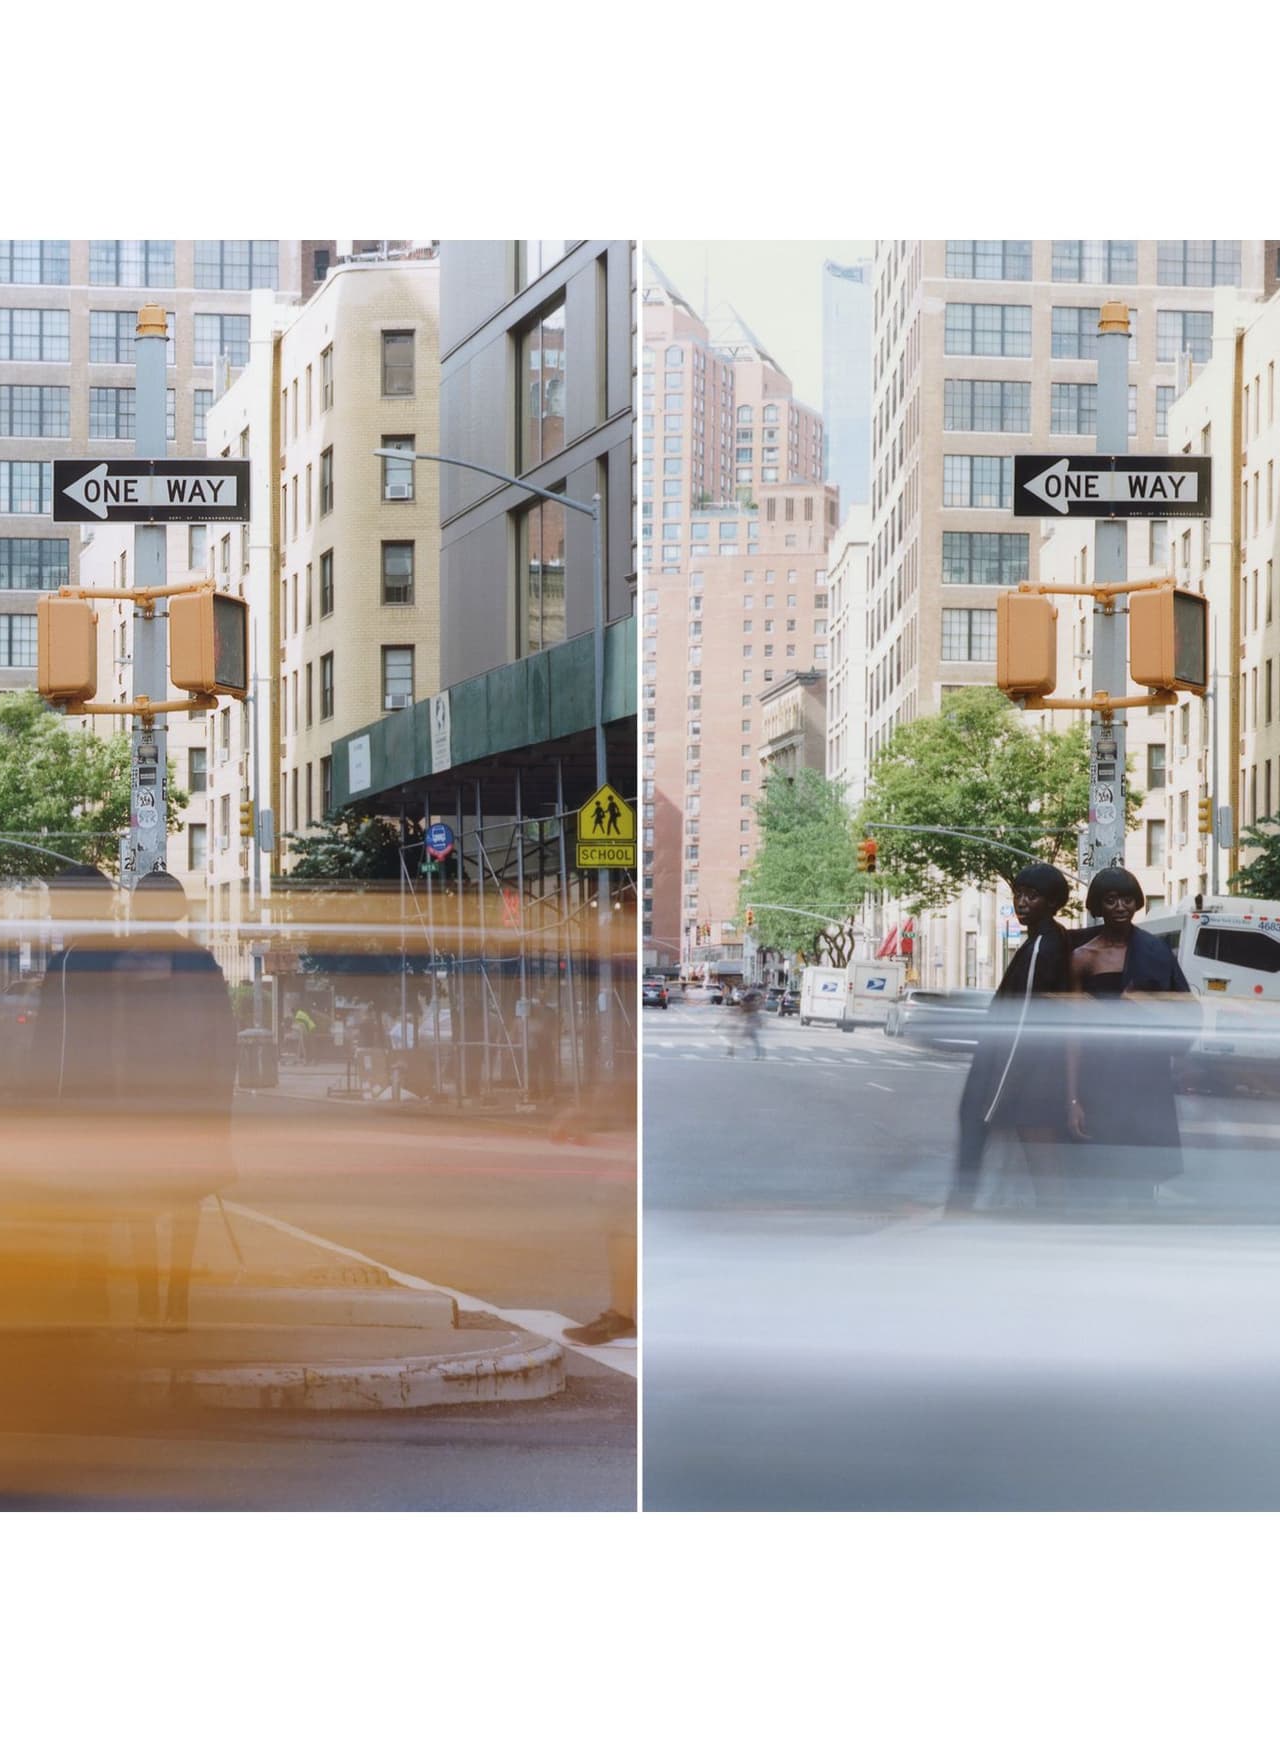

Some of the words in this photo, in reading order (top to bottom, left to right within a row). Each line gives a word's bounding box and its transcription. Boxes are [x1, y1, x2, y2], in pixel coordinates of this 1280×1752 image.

[84, 479, 138, 503] ONE
[166, 479, 224, 503] WAY
[1044, 474, 1099, 498] ONE
[1128, 475, 1186, 498] WAY
[581, 848, 632, 861] SCHOOL
